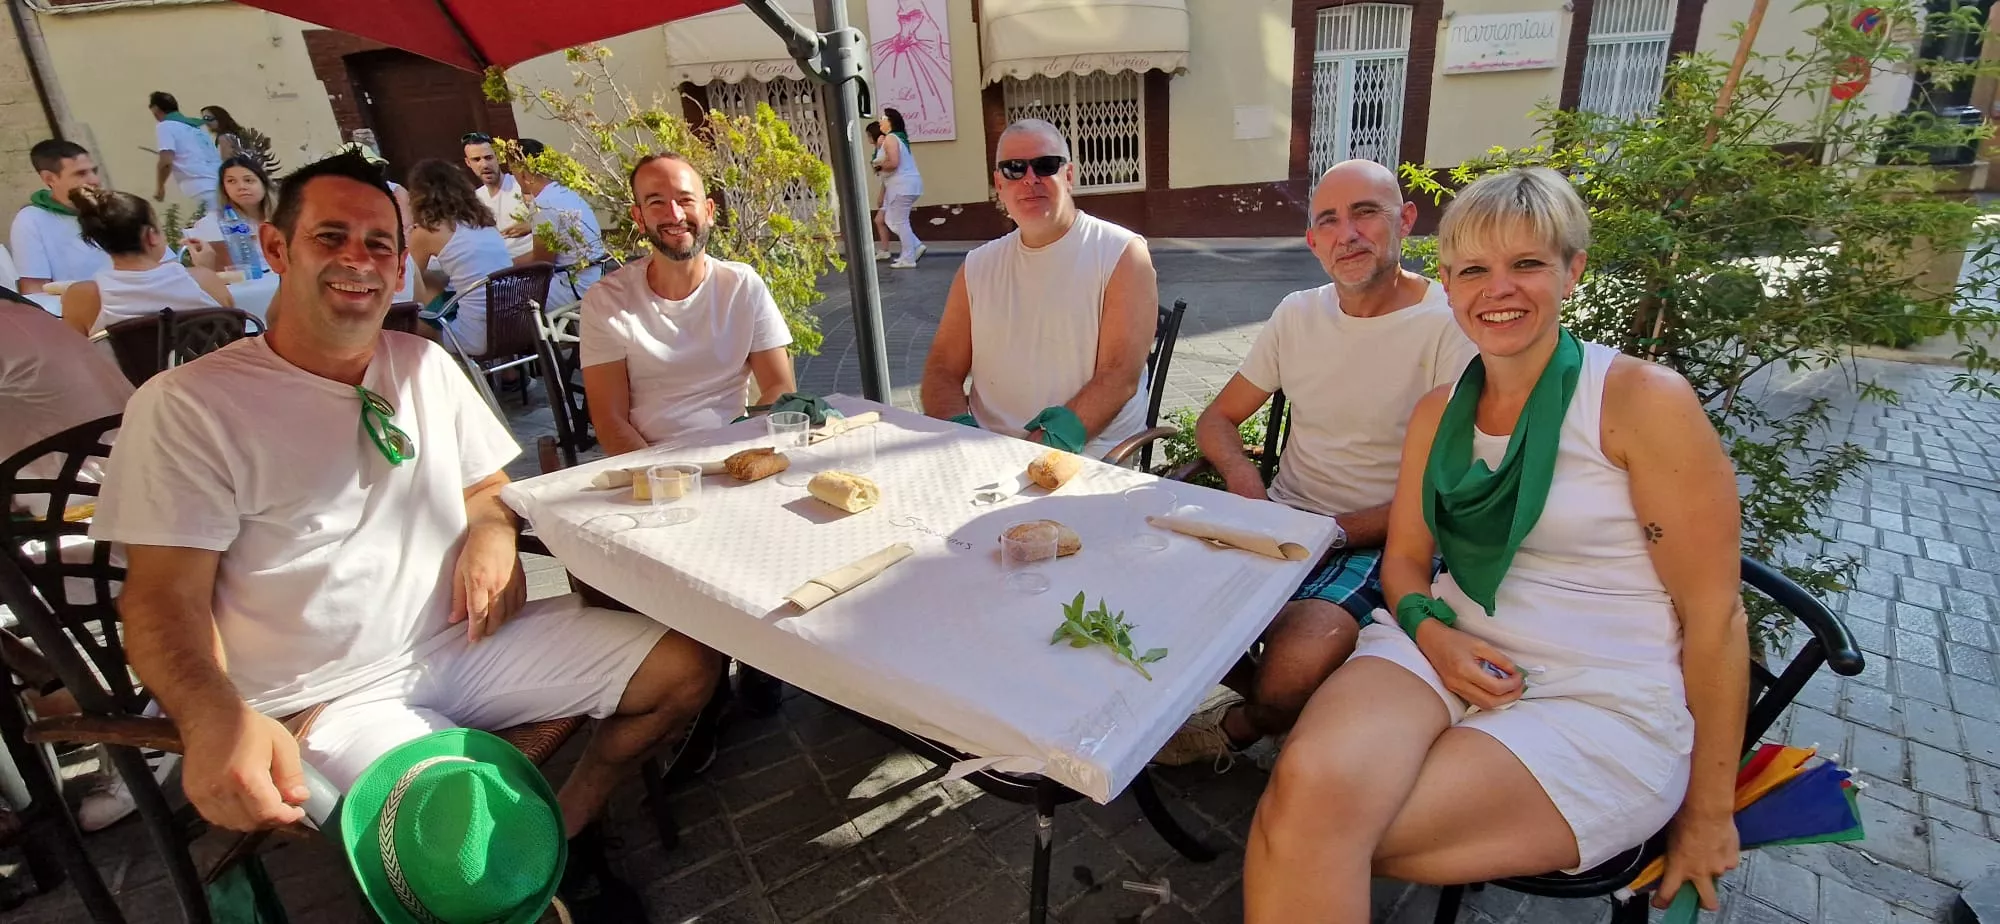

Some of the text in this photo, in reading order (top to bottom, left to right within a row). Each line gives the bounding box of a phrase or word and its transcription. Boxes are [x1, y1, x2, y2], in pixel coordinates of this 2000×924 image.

[1451, 19, 1554, 43] marramiau
[710, 60, 794, 77] La Casa
[1044, 55, 1061, 71] de
[1070, 55, 1092, 69] las
